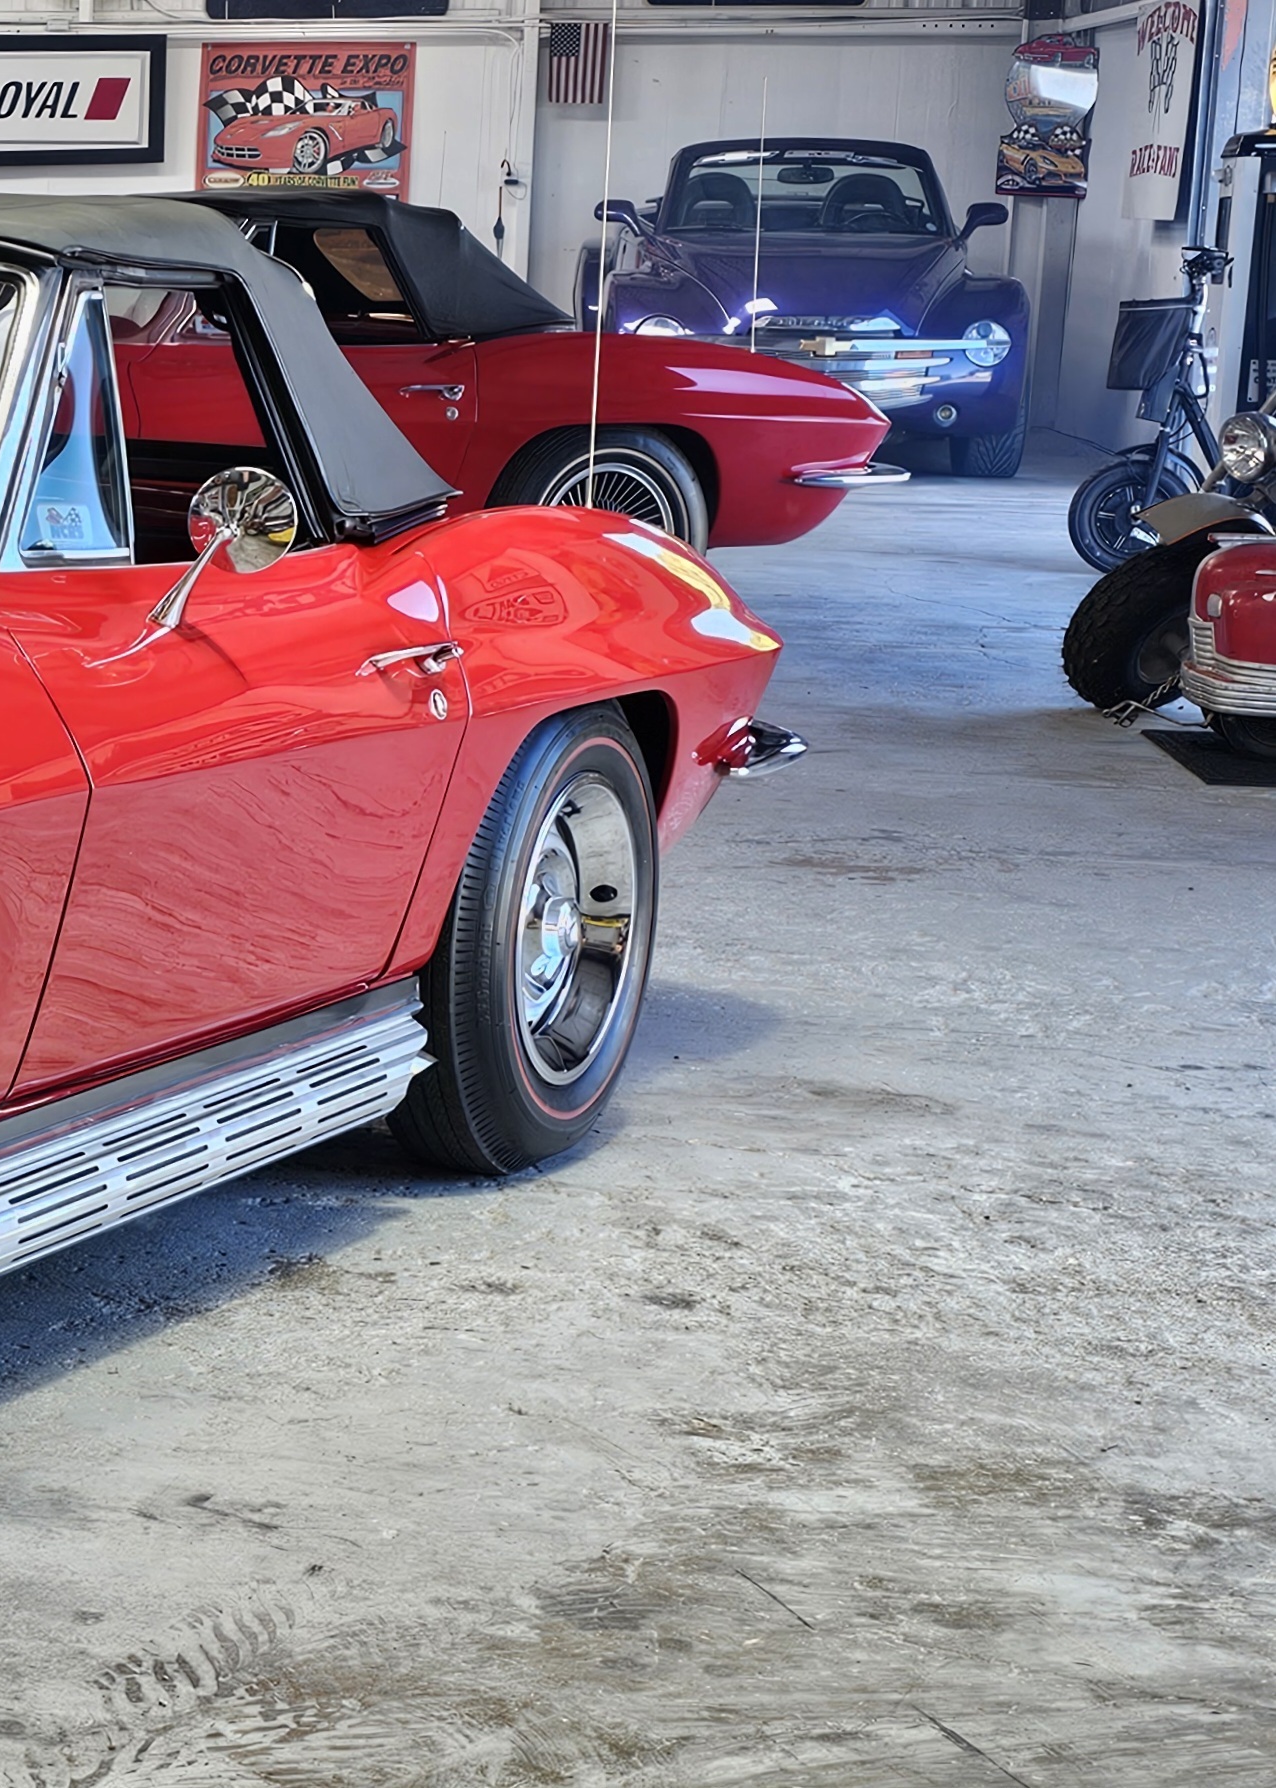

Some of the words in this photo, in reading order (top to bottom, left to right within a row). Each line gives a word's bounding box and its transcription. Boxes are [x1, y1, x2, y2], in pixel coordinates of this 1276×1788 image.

[1137, 1, 1198, 56] WELCOME
[209, 53, 338, 76] CORVETTE
[340, 53, 409, 76] EXPO
[248, 173, 269, 187] 40
